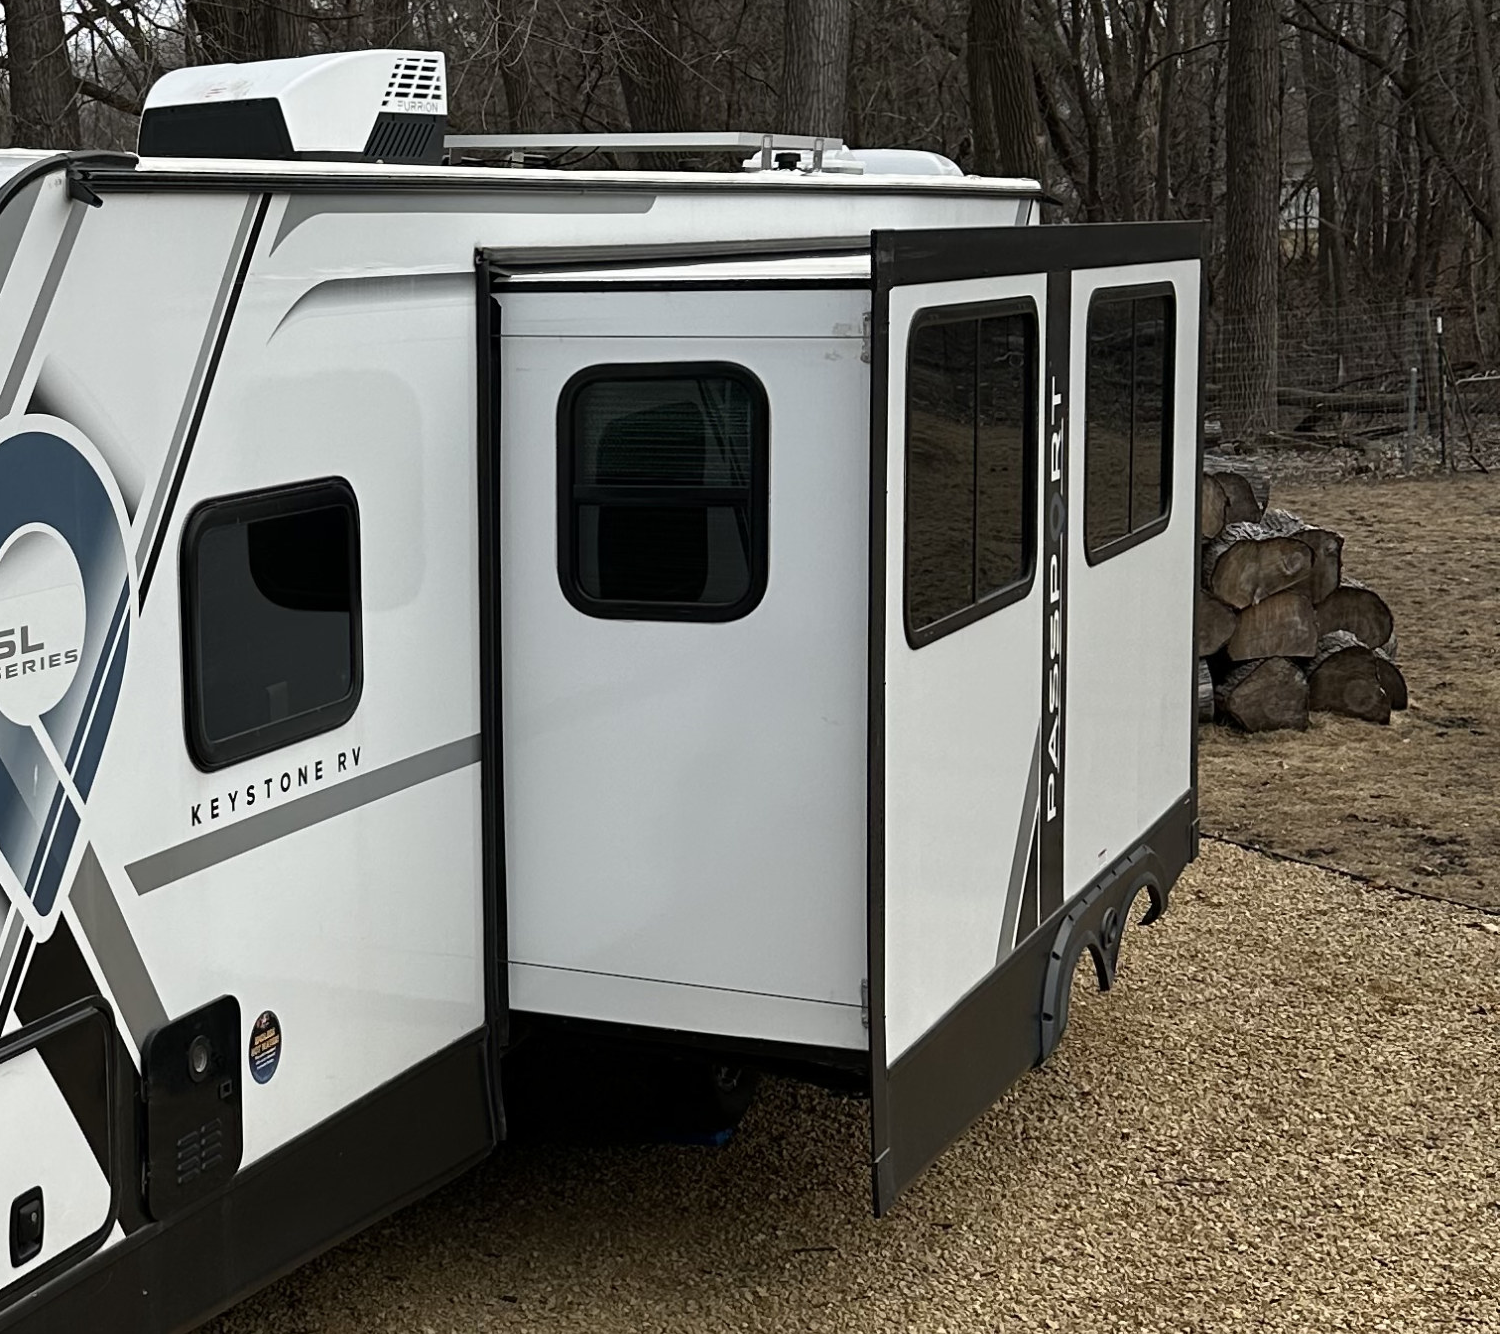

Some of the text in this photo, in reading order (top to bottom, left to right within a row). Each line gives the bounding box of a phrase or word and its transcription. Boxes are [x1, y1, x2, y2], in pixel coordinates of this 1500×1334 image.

[1046, 375, 1066, 823] PASSPORT
[191, 746, 361, 827] KEYSTONE RV
